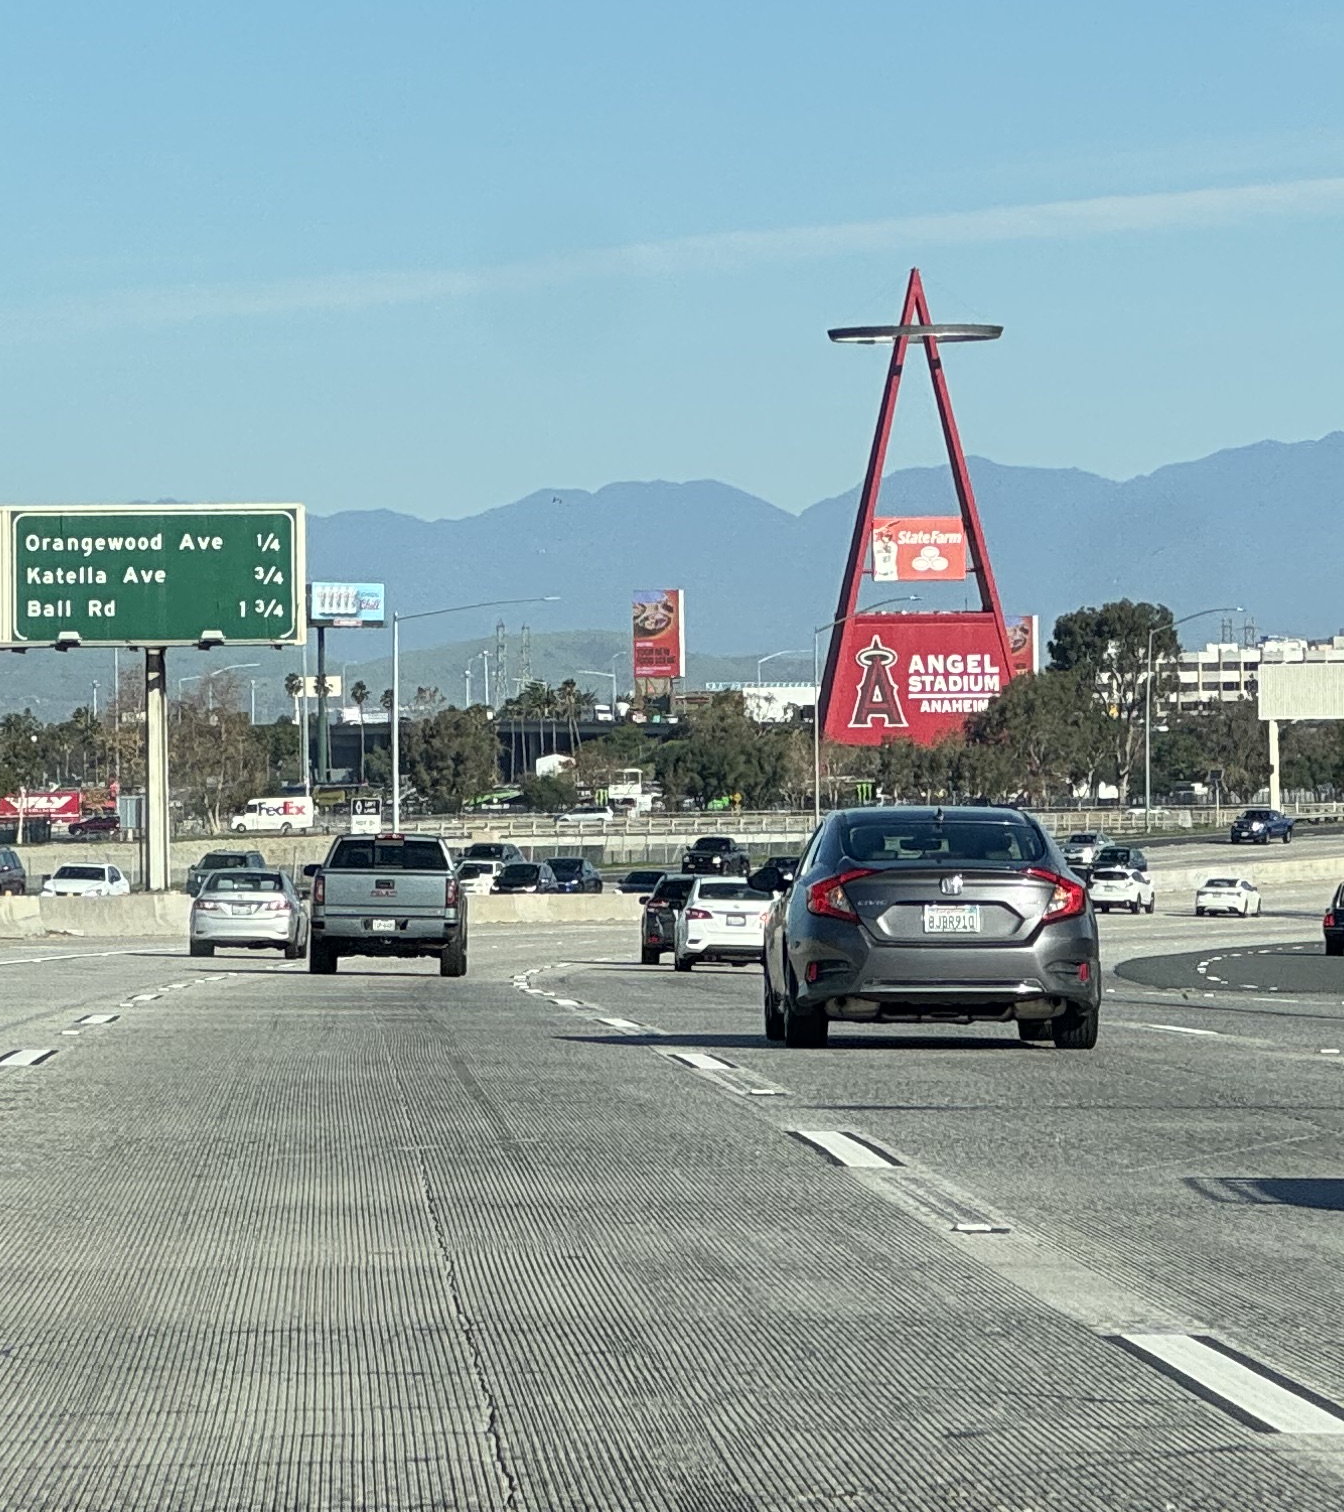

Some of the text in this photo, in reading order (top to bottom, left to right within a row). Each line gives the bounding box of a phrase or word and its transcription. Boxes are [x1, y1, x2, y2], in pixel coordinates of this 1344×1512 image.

[25, 534, 163, 556] Orangewood
[178, 533, 224, 550] Ave
[26, 566, 107, 584] Katella
[122, 566, 167, 583] Ave
[26, 600, 72, 617] Ball
[87, 599, 116, 617] Rd
[238, 601, 247, 618] 1
[908, 654, 1000, 674] ANGEL
[908, 675, 1000, 692] STADIUM
[920, 699, 989, 713] ANAHEIM
[257, 801, 306, 816] FedEx
